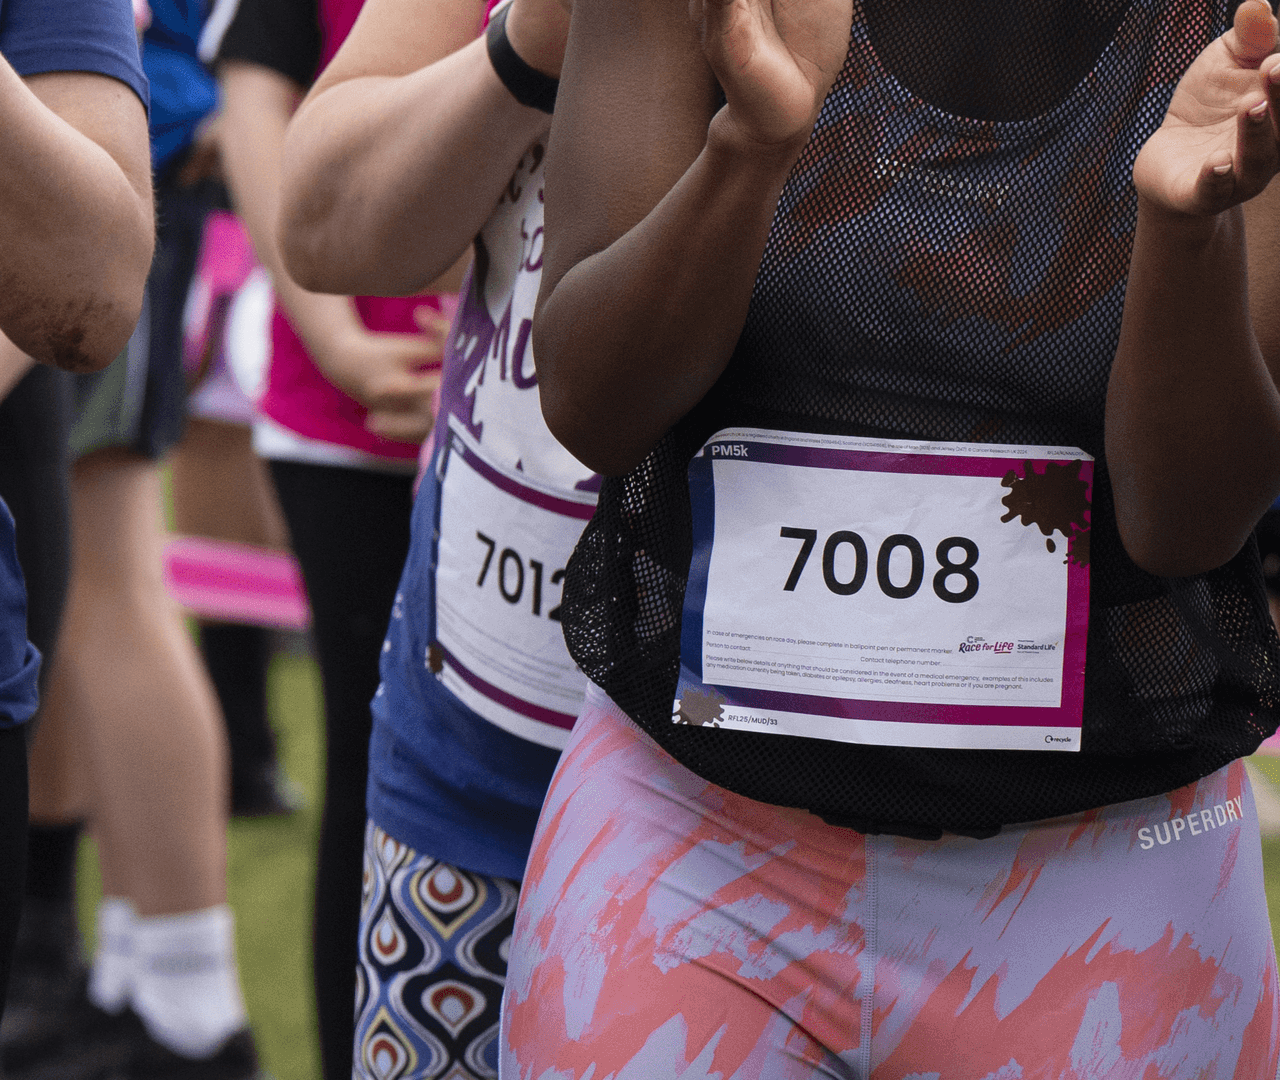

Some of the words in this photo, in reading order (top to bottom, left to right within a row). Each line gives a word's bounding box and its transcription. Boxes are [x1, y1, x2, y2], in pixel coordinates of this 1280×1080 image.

[712, 445, 749, 459] PM5k
[779, 526, 981, 604] 7008
[958, 642, 982, 654] Race
[982, 643, 995, 651] for
[994, 641, 1015, 652] Life
[1017, 643, 1045, 651] Standard
[727, 713, 778, 727] RFL25/MUD/33
[1137, 795, 1244, 850] SUPERDRY
